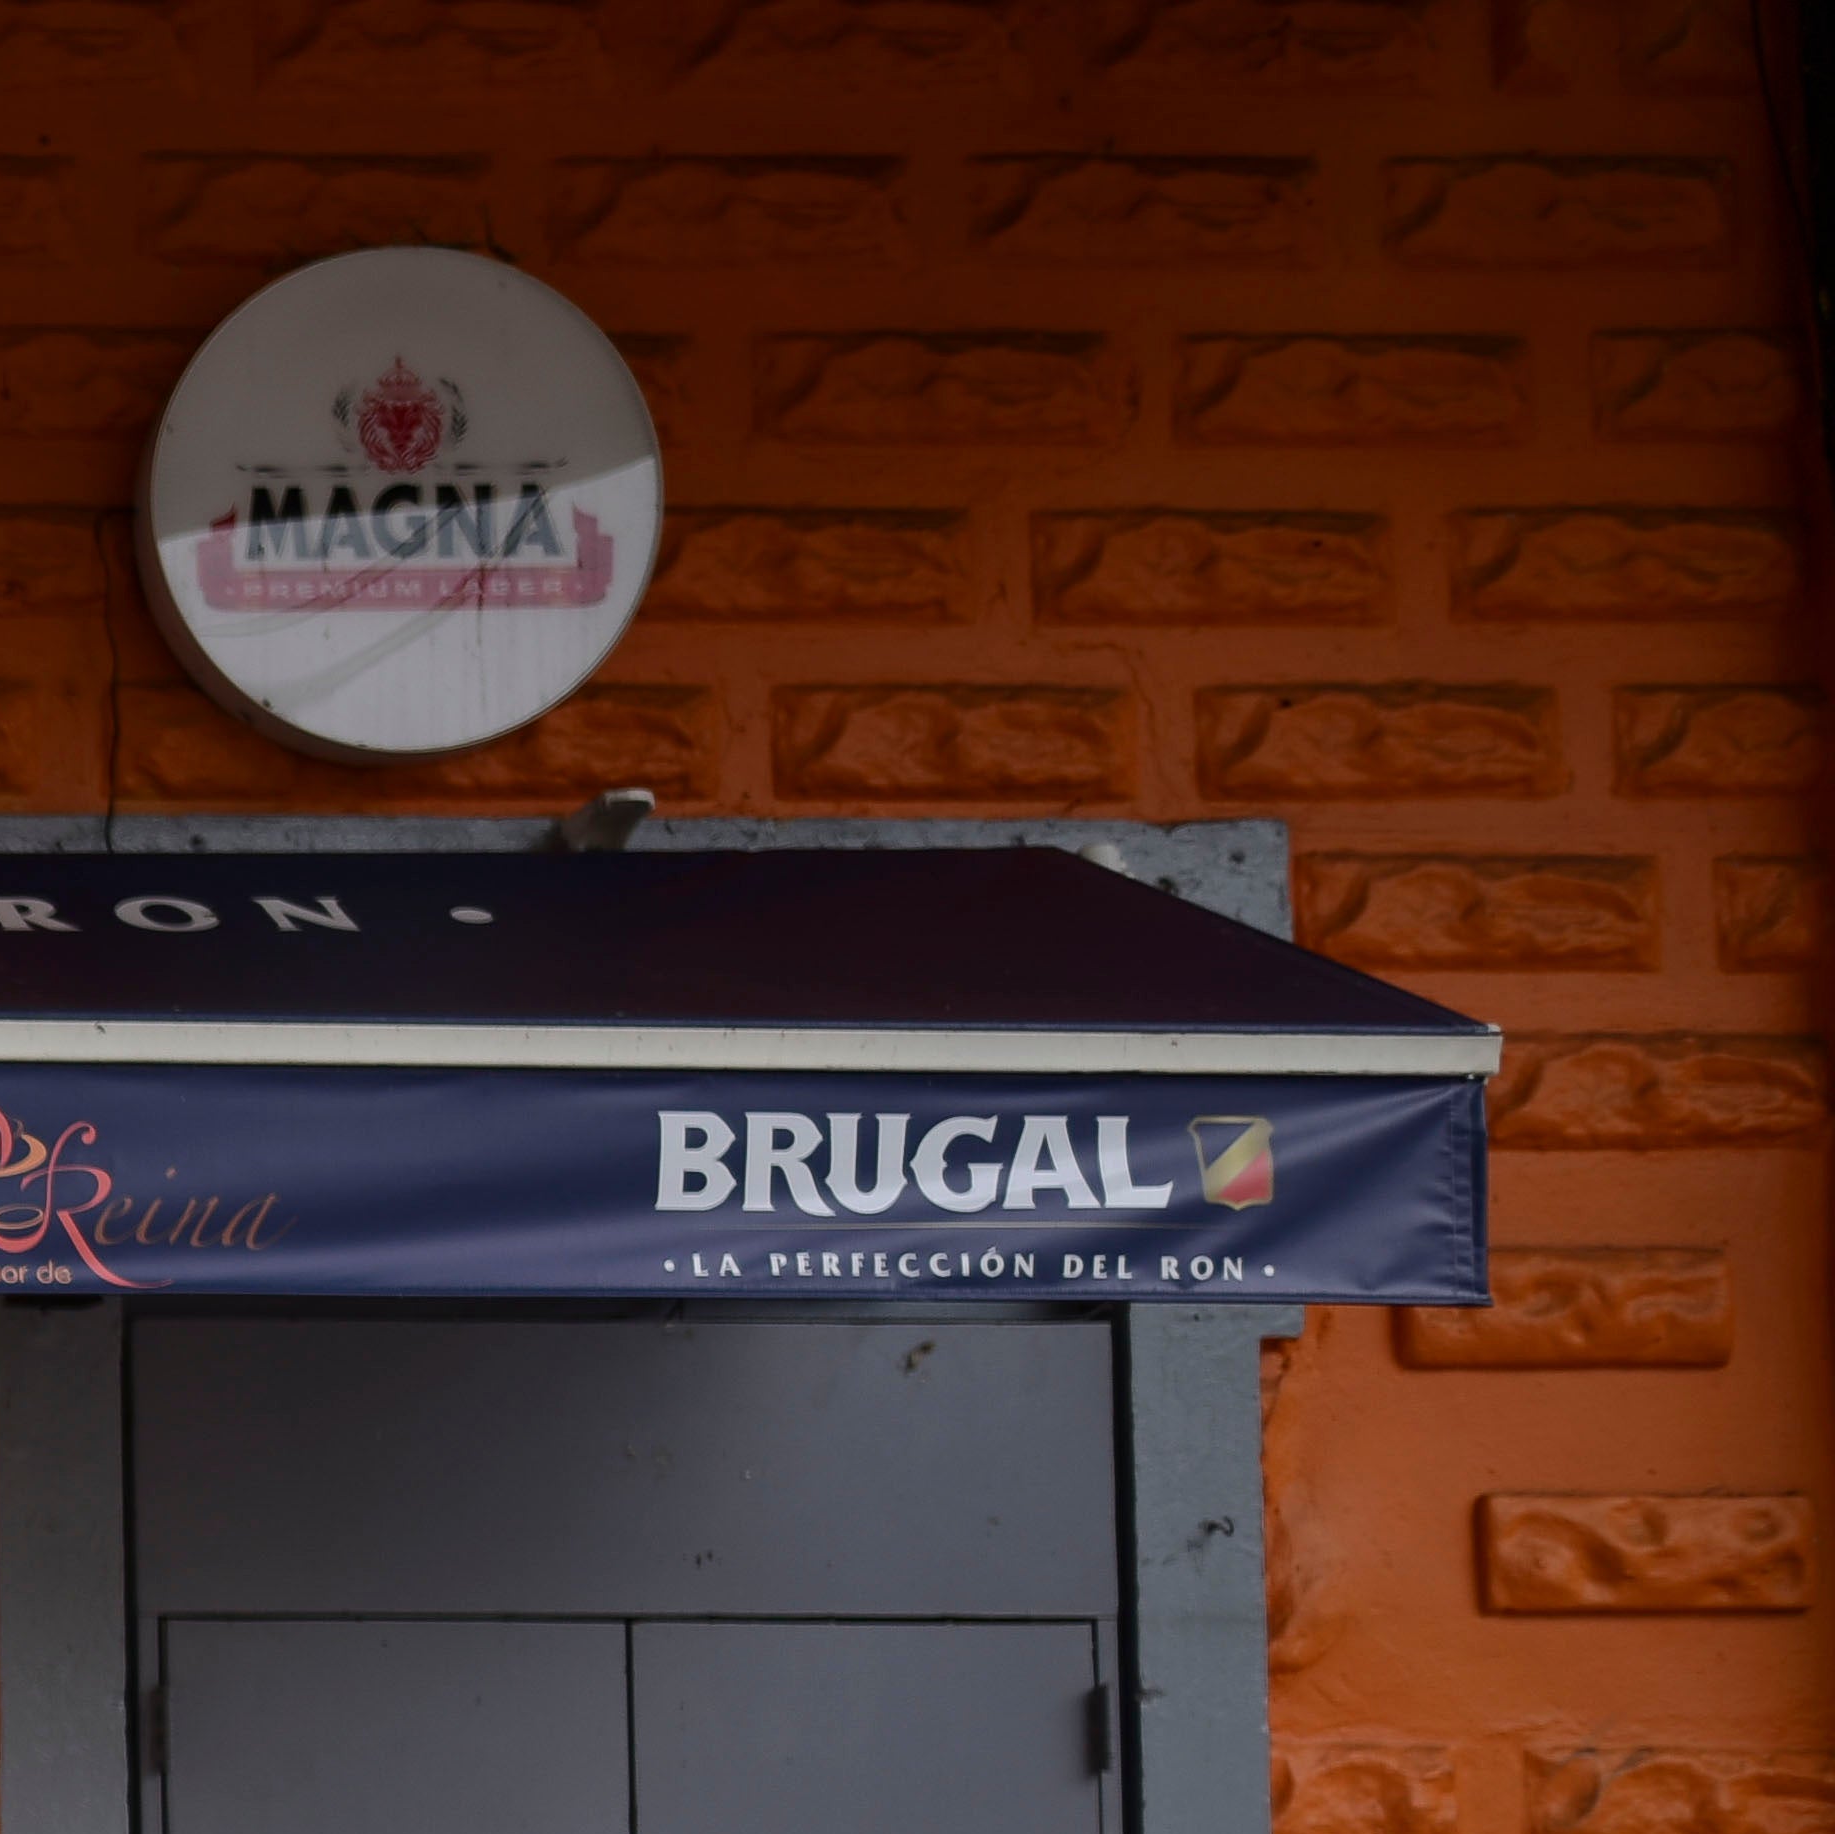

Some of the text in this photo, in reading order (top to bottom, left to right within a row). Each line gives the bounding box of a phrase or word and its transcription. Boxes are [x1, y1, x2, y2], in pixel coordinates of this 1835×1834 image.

[244, 481, 564, 561] MAGNA
[243, 580, 422, 600] PREMIUM
[654, 1110, 1175, 1217] BRUGAL
[16, 1120, 297, 1288] Reina
[35, 1259, 73, 1285] de
[691, 1246, 1244, 1282] LA PERFECCIÓN DEL RON
